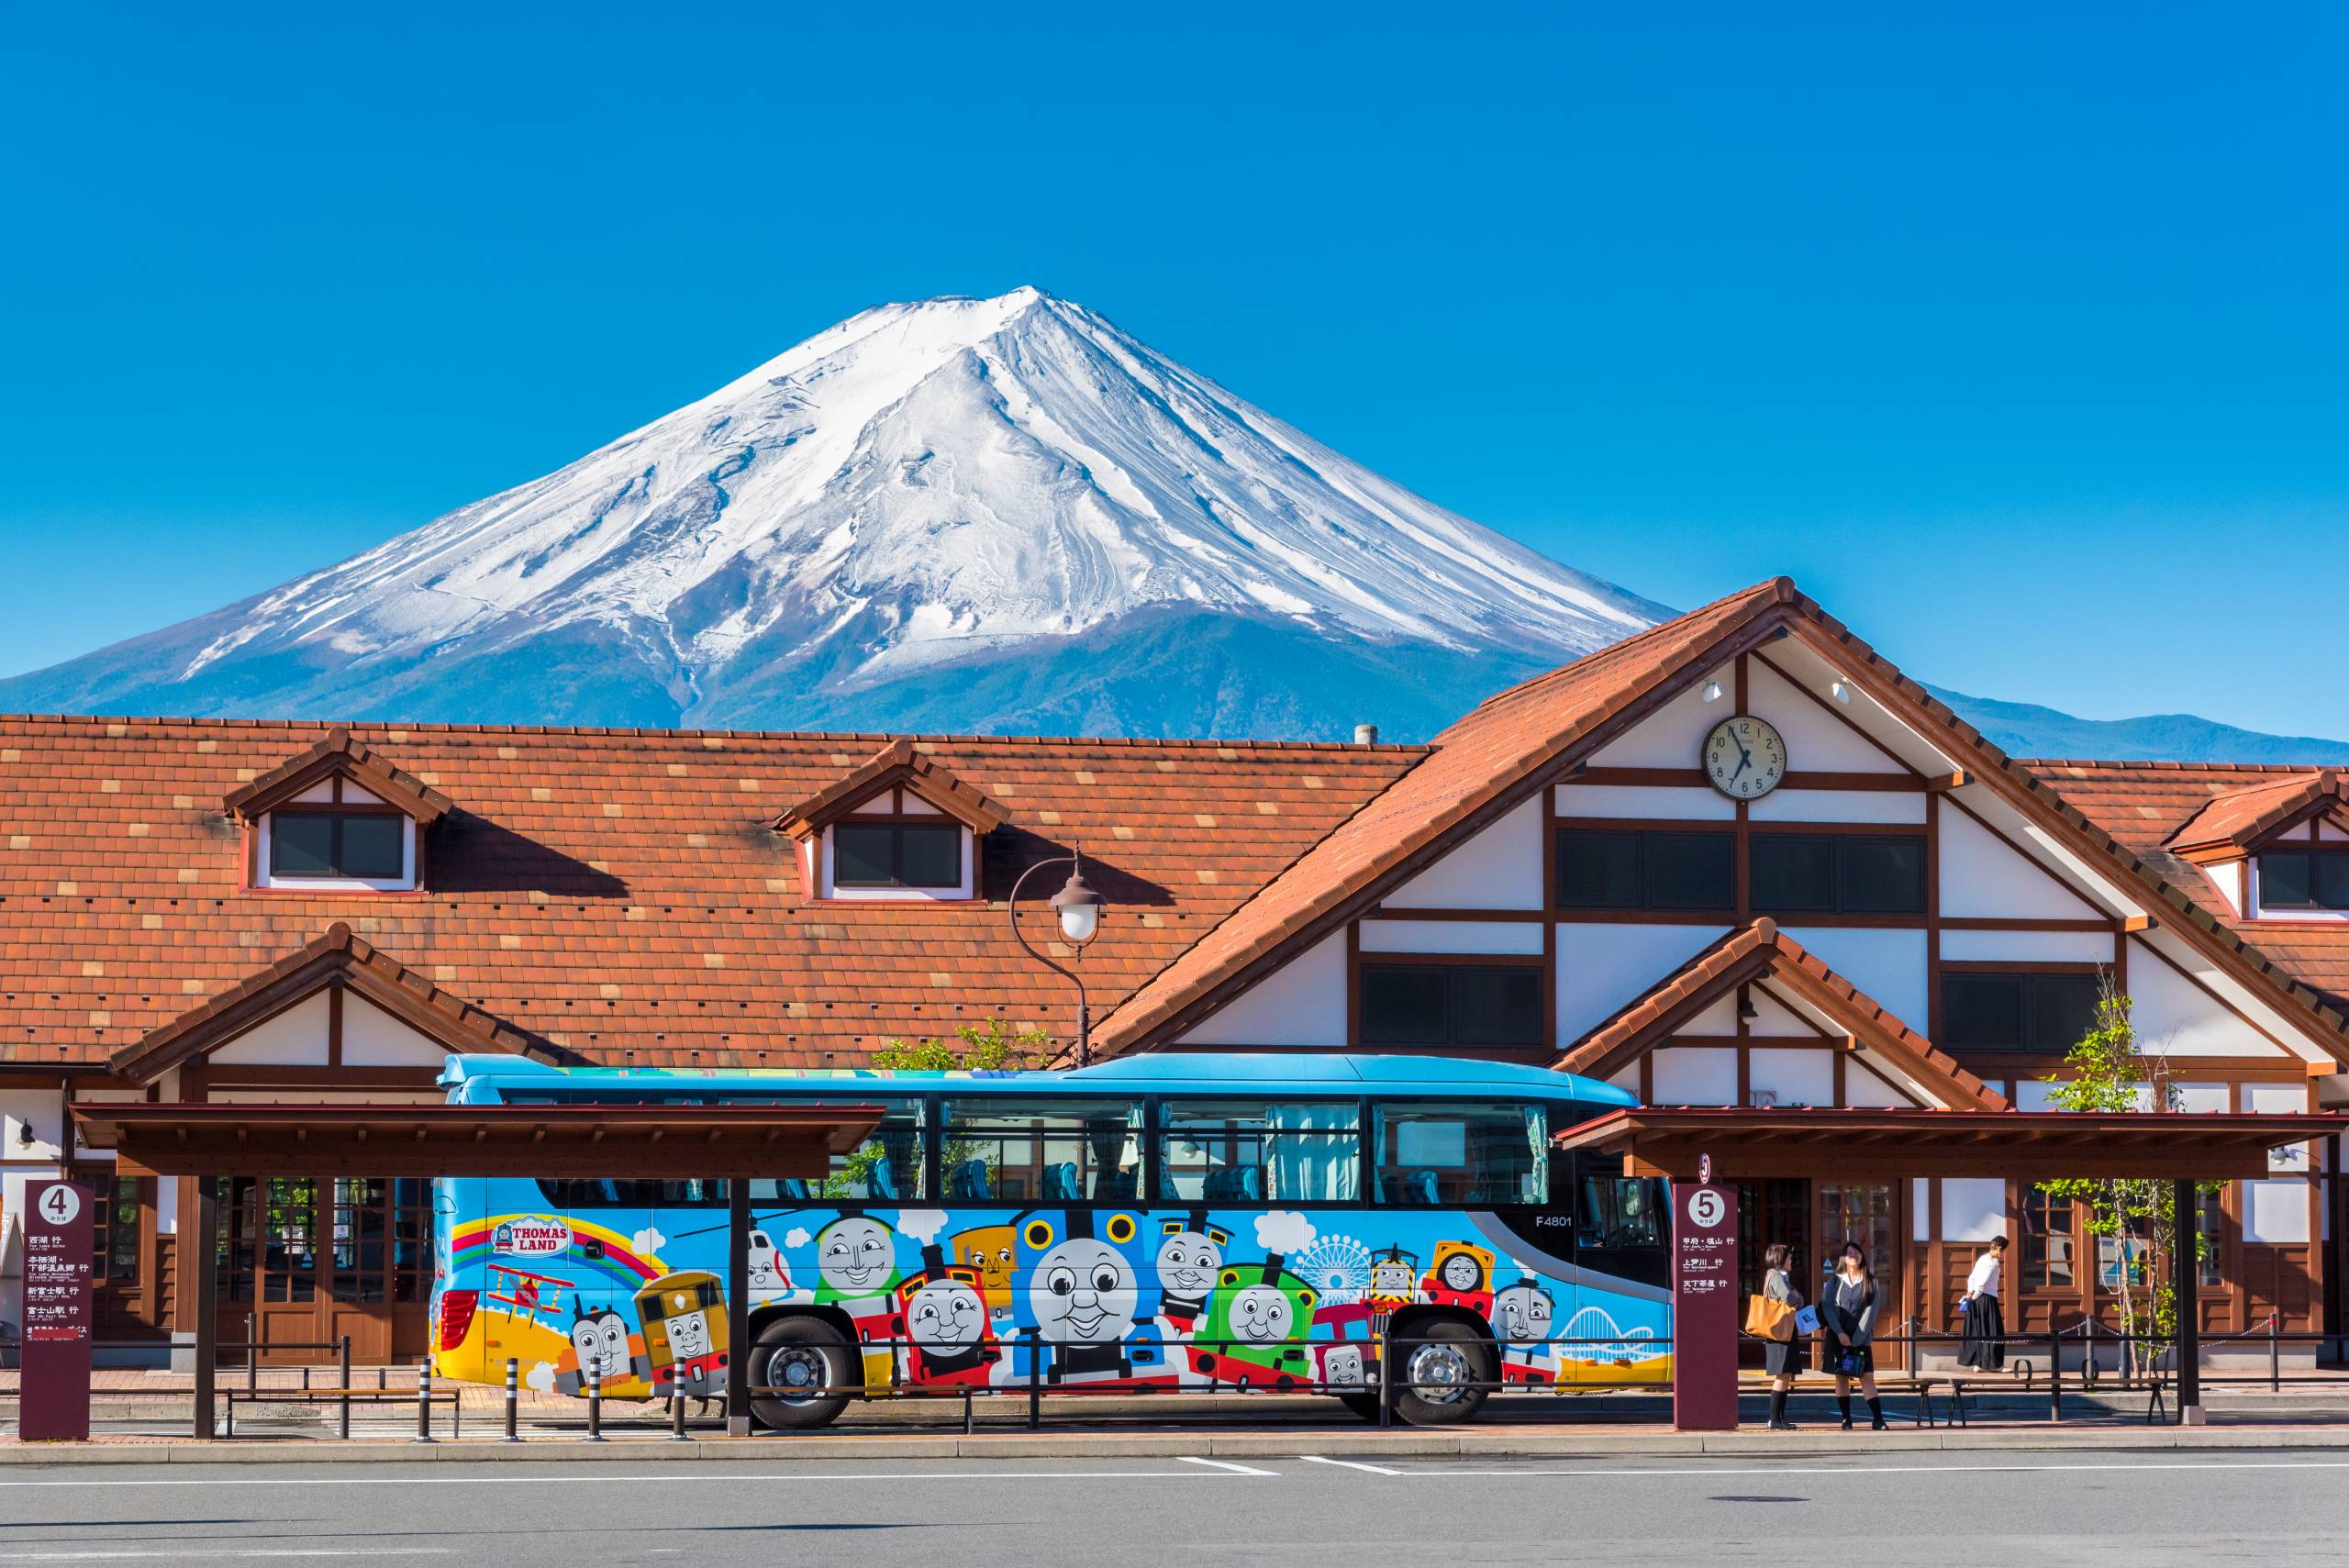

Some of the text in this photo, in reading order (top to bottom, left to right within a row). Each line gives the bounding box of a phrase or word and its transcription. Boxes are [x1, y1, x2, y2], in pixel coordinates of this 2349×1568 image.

[1740, 723, 1749, 734] 12
[1716, 738, 1725, 747] 10
[1766, 739, 1772, 749] 2
[1712, 752, 1718, 762] 9
[1771, 754, 1777, 763] 3
[1717, 767, 1723, 777] 8
[1767, 768, 1774, 777] 4
[1729, 778, 1734, 788] 7
[1742, 782, 1748, 792] 6
[1756, 779, 1762, 789] 5
[48, 1189, 66, 1214] 4
[1698, 1193, 1714, 1218] 5
[1536, 1217, 1571, 1227] F4801
[513, 1229, 567, 1239] THOMAS
[519, 1240, 556, 1251] LAND
[28, 1286, 65, 1295] 新富士駅
